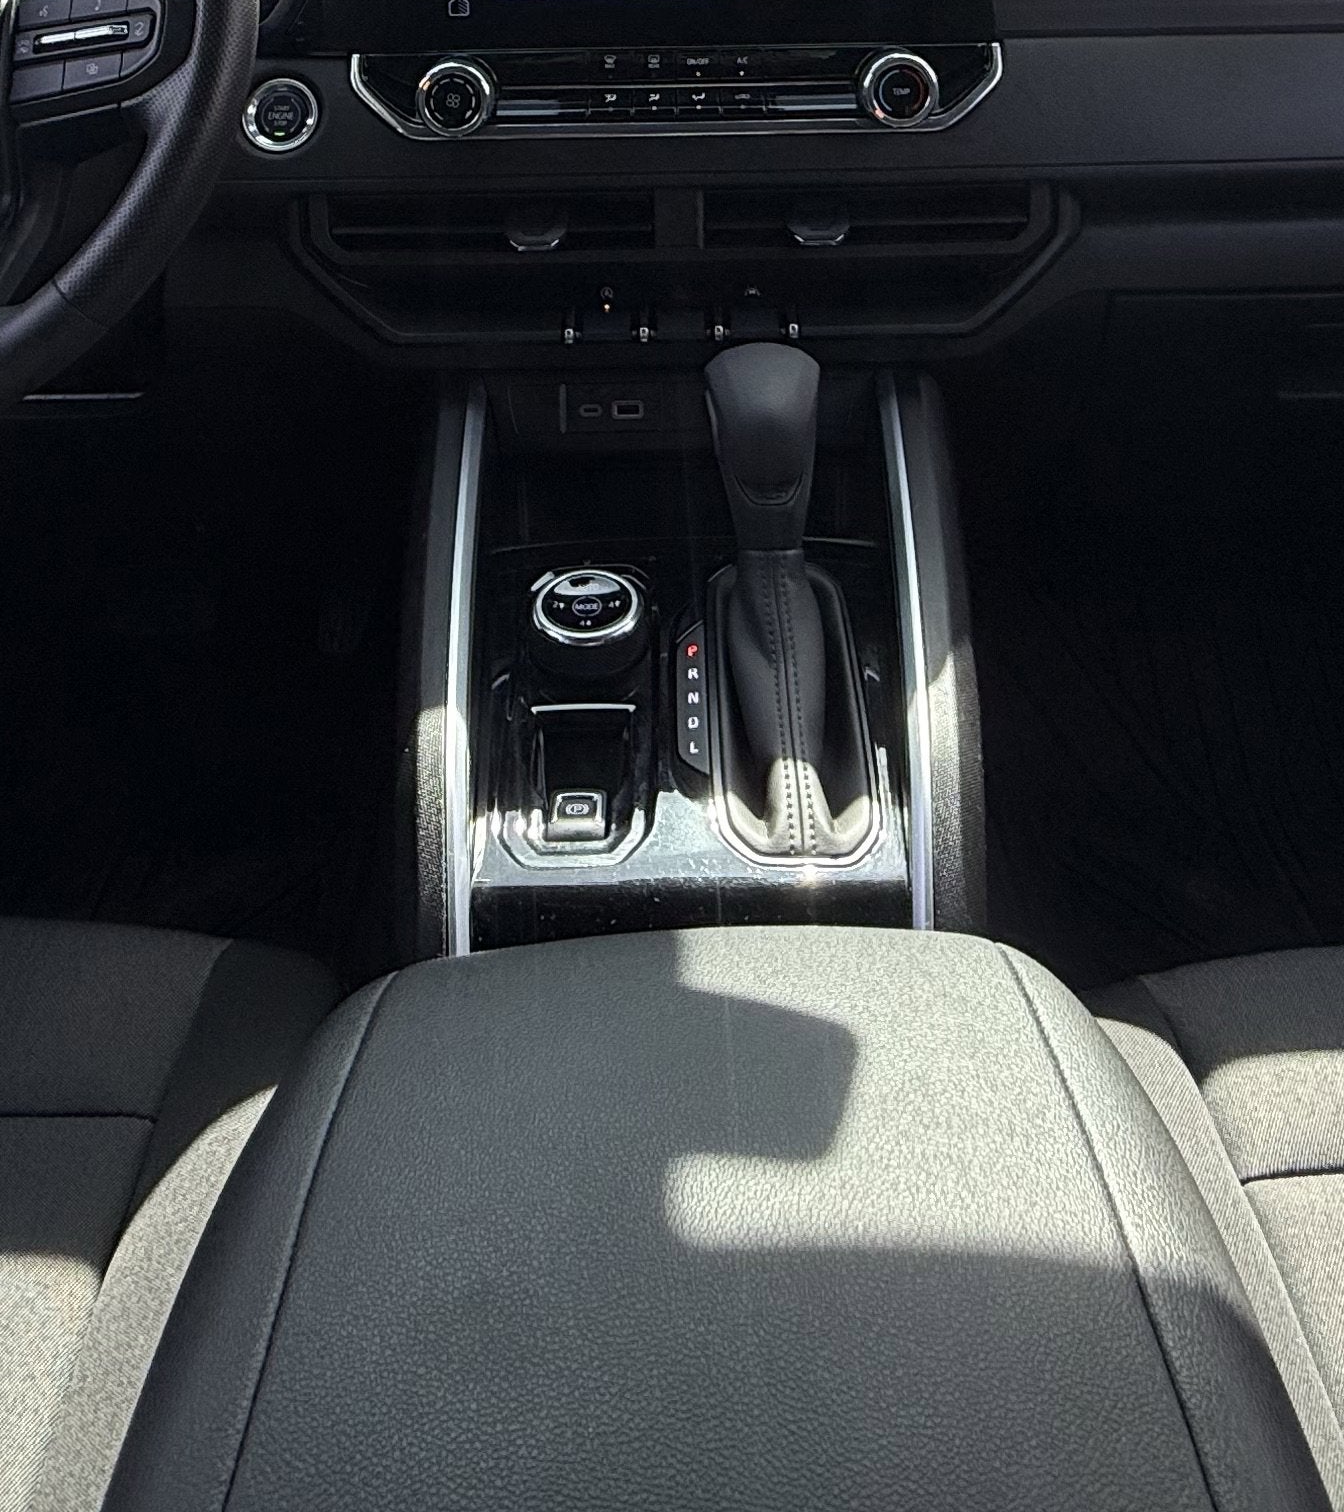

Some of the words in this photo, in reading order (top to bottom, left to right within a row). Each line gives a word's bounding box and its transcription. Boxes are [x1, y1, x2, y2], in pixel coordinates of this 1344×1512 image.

[268, 112, 294, 120] ENGINE
[687, 645, 698, 657] P
[687, 667, 699, 680] R
[687, 692, 699, 704] N
[687, 716, 699, 729] D
[689, 741, 699, 754] L
